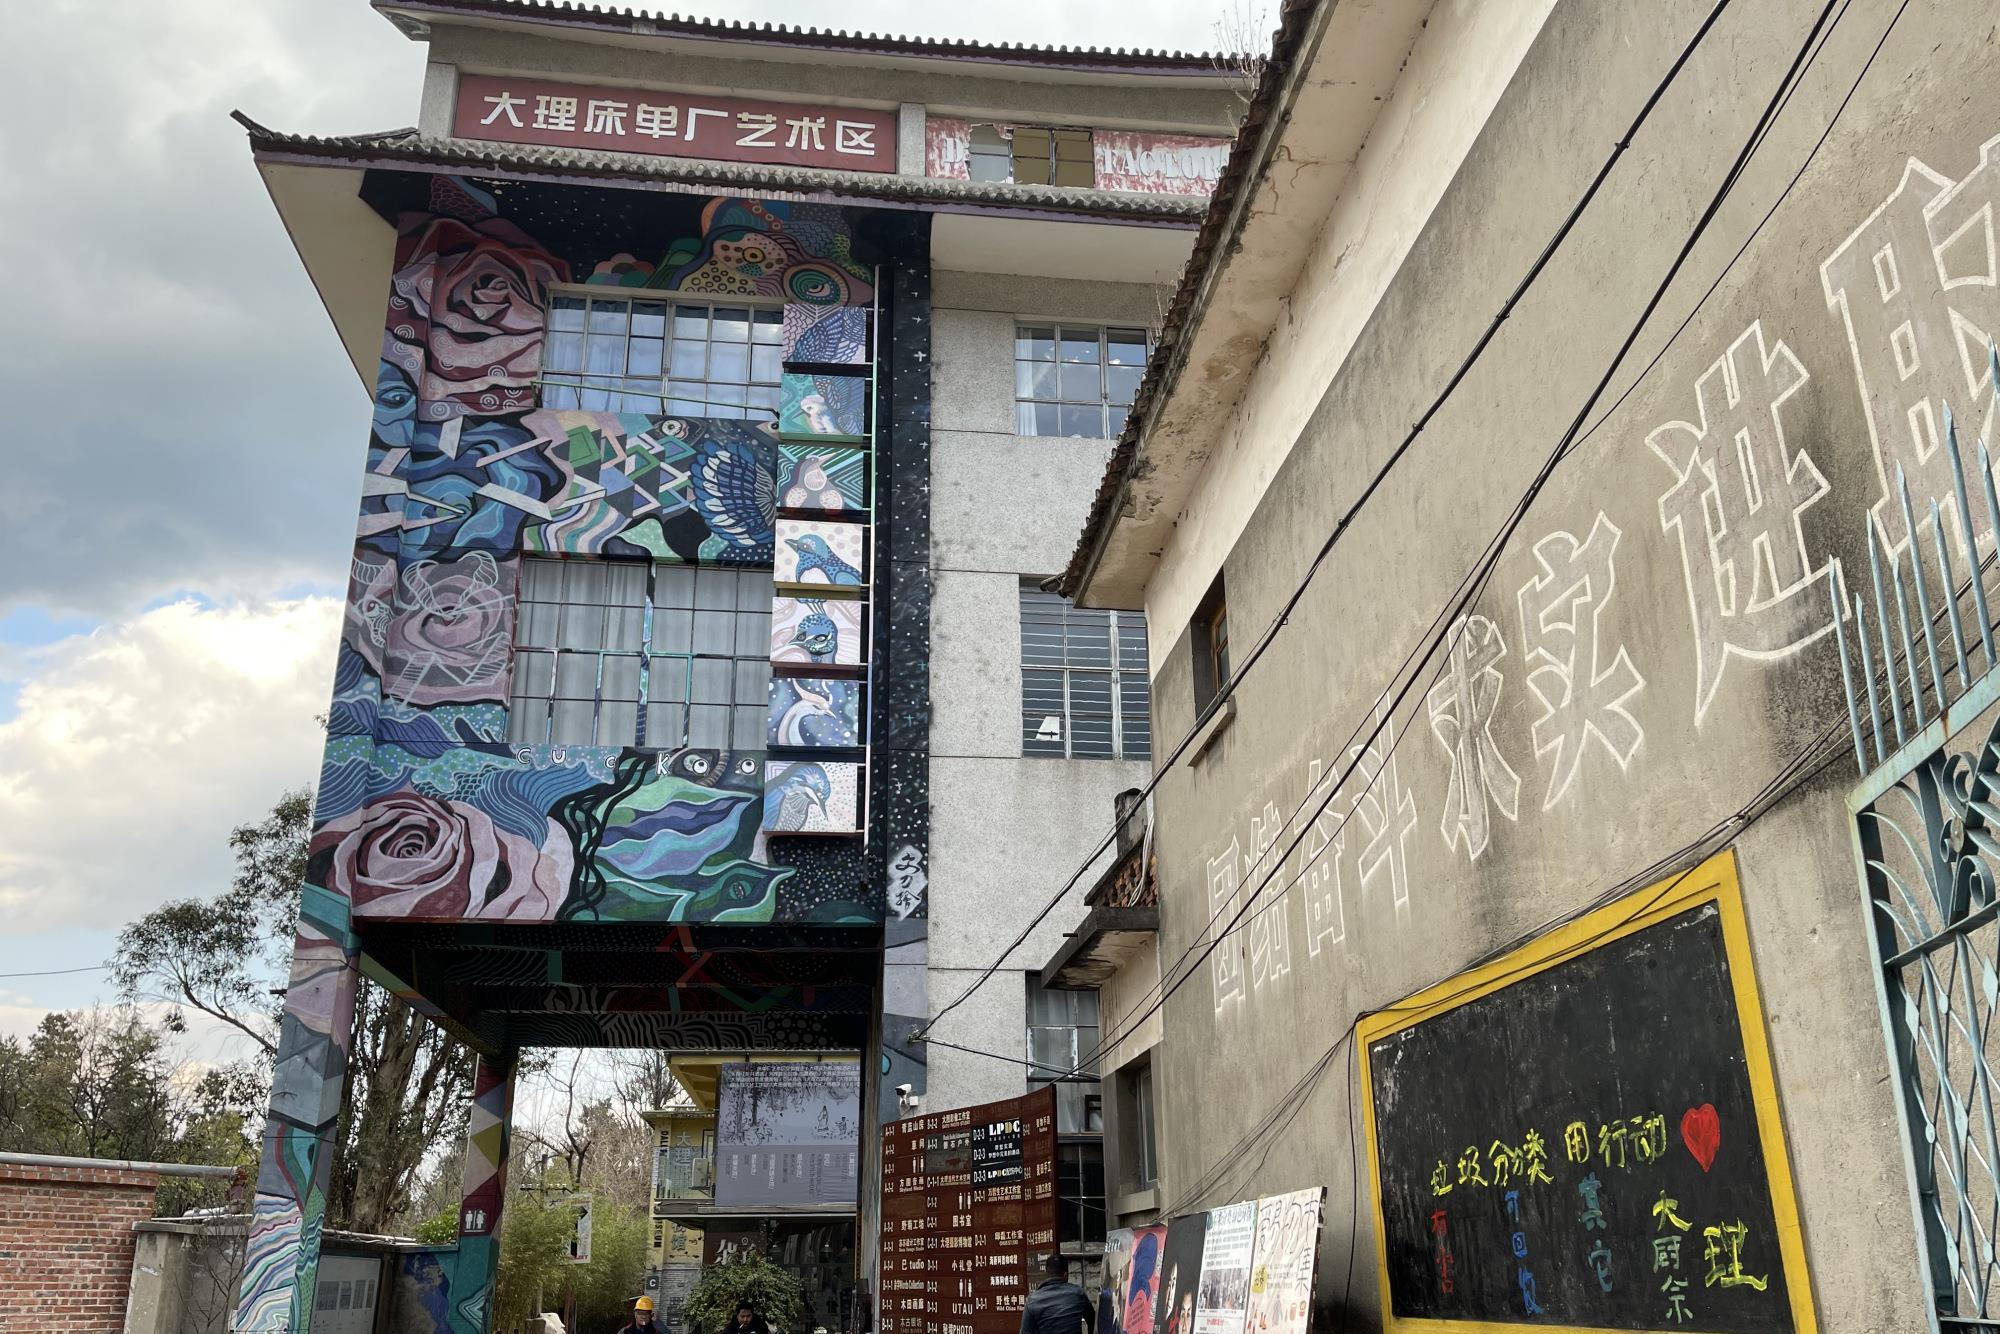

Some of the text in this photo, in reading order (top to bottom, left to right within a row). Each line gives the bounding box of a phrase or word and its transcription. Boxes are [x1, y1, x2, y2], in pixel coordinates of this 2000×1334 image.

[480, 91, 877, 157] 大理床单厂艺术区
[989, 1120, 1020, 1136] LPDC
[953, 1214, 972, 1227] 图书室
[952, 1260, 972, 1271] 小礼堂
[649, 1279, 656, 1287] C
[996, 1295, 1025, 1305] 野性中国
[952, 1302, 972, 1315] UTAU
